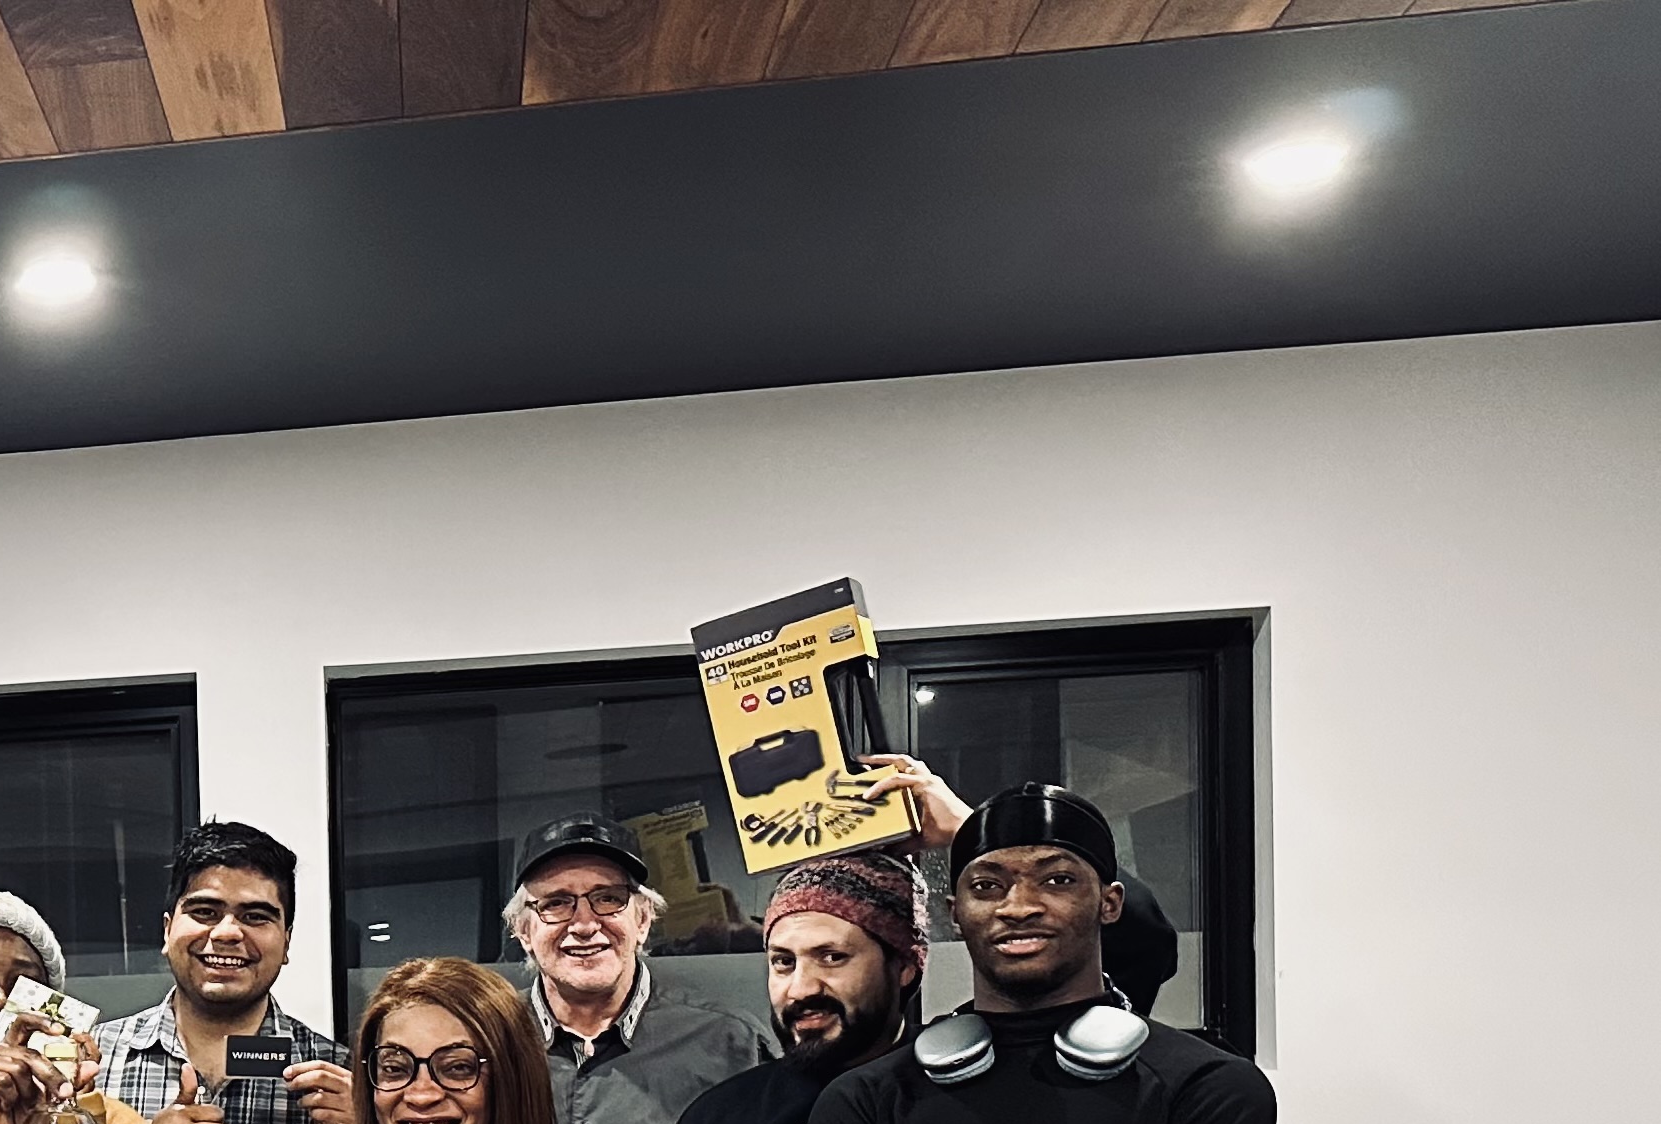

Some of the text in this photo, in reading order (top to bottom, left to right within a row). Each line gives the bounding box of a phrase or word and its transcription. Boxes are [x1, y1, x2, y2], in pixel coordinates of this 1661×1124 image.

[700, 630, 773, 661] WORKPRO
[728, 634, 817, 670] Household Tool Kit
[707, 666, 725, 678] 40
[730, 665, 763, 681] Trousse
[764, 661, 775, 671] De
[777, 649, 816, 667] Bricolage
[741, 679, 752, 688] La
[752, 669, 782, 684] Maison
[231, 1051, 287, 1061] WINNERS
